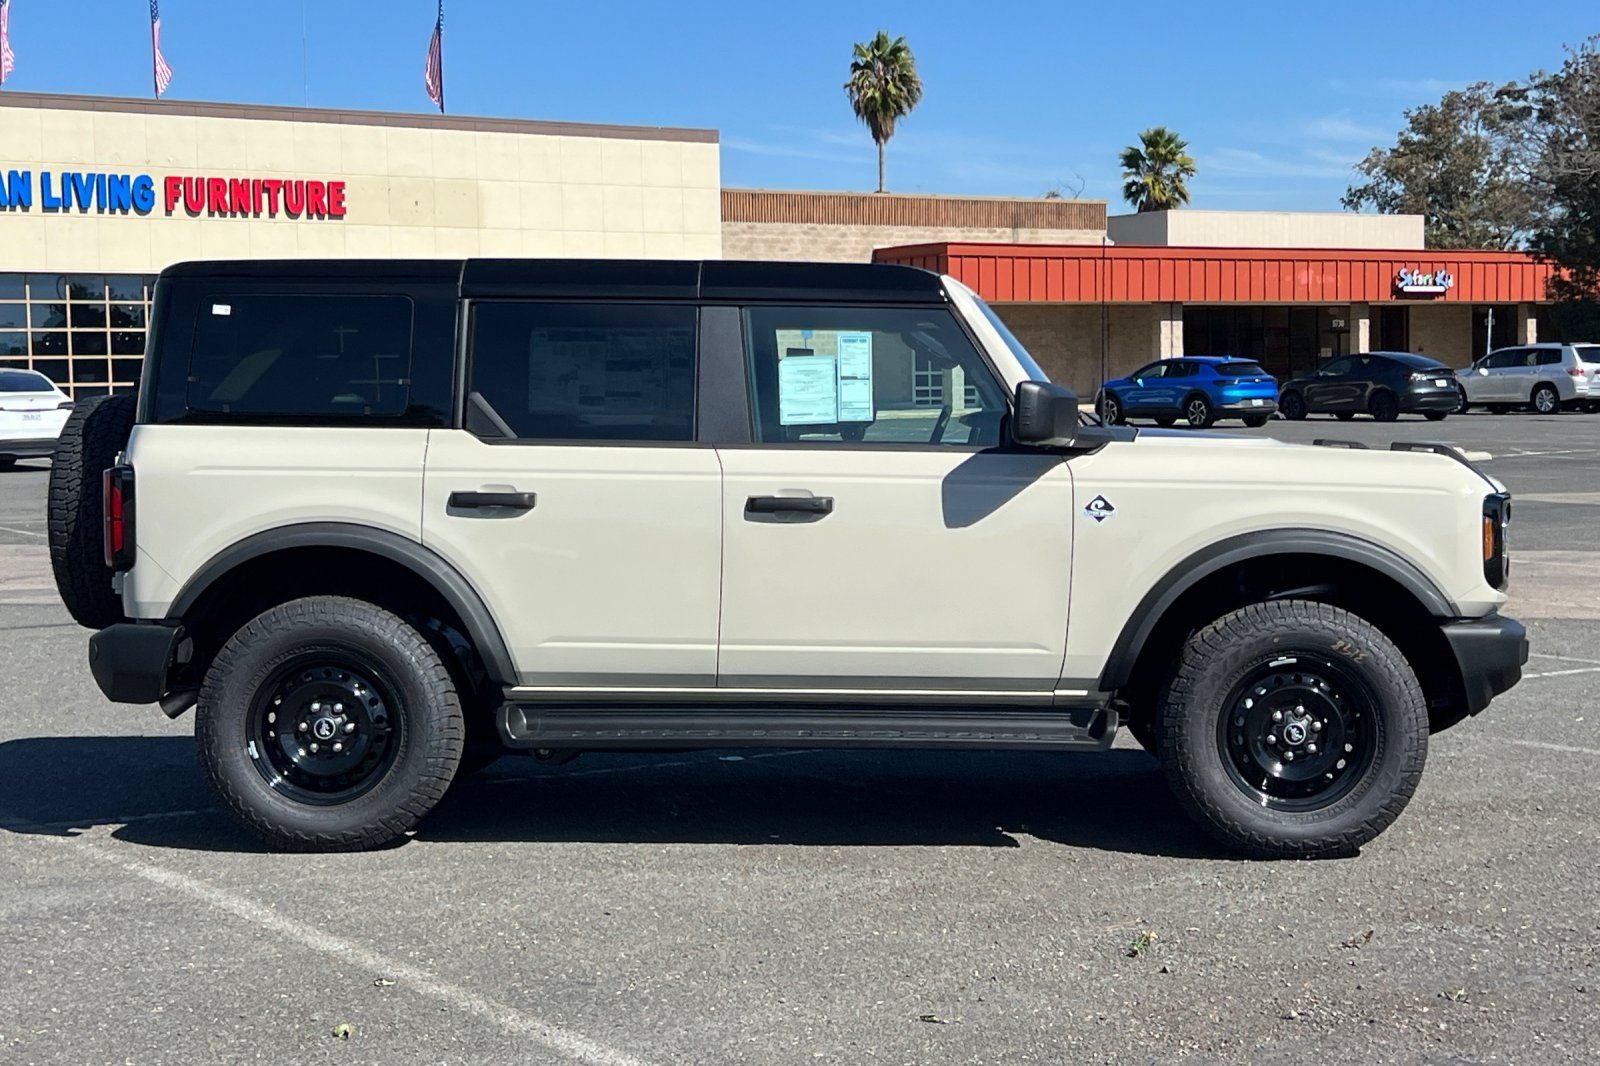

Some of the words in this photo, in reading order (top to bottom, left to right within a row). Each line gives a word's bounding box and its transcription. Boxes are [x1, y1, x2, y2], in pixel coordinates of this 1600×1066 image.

[41, 171, 156, 212] LIVING
[164, 176, 347, 217] FURNITURE
[1435, 269, 1455, 289] Kid
